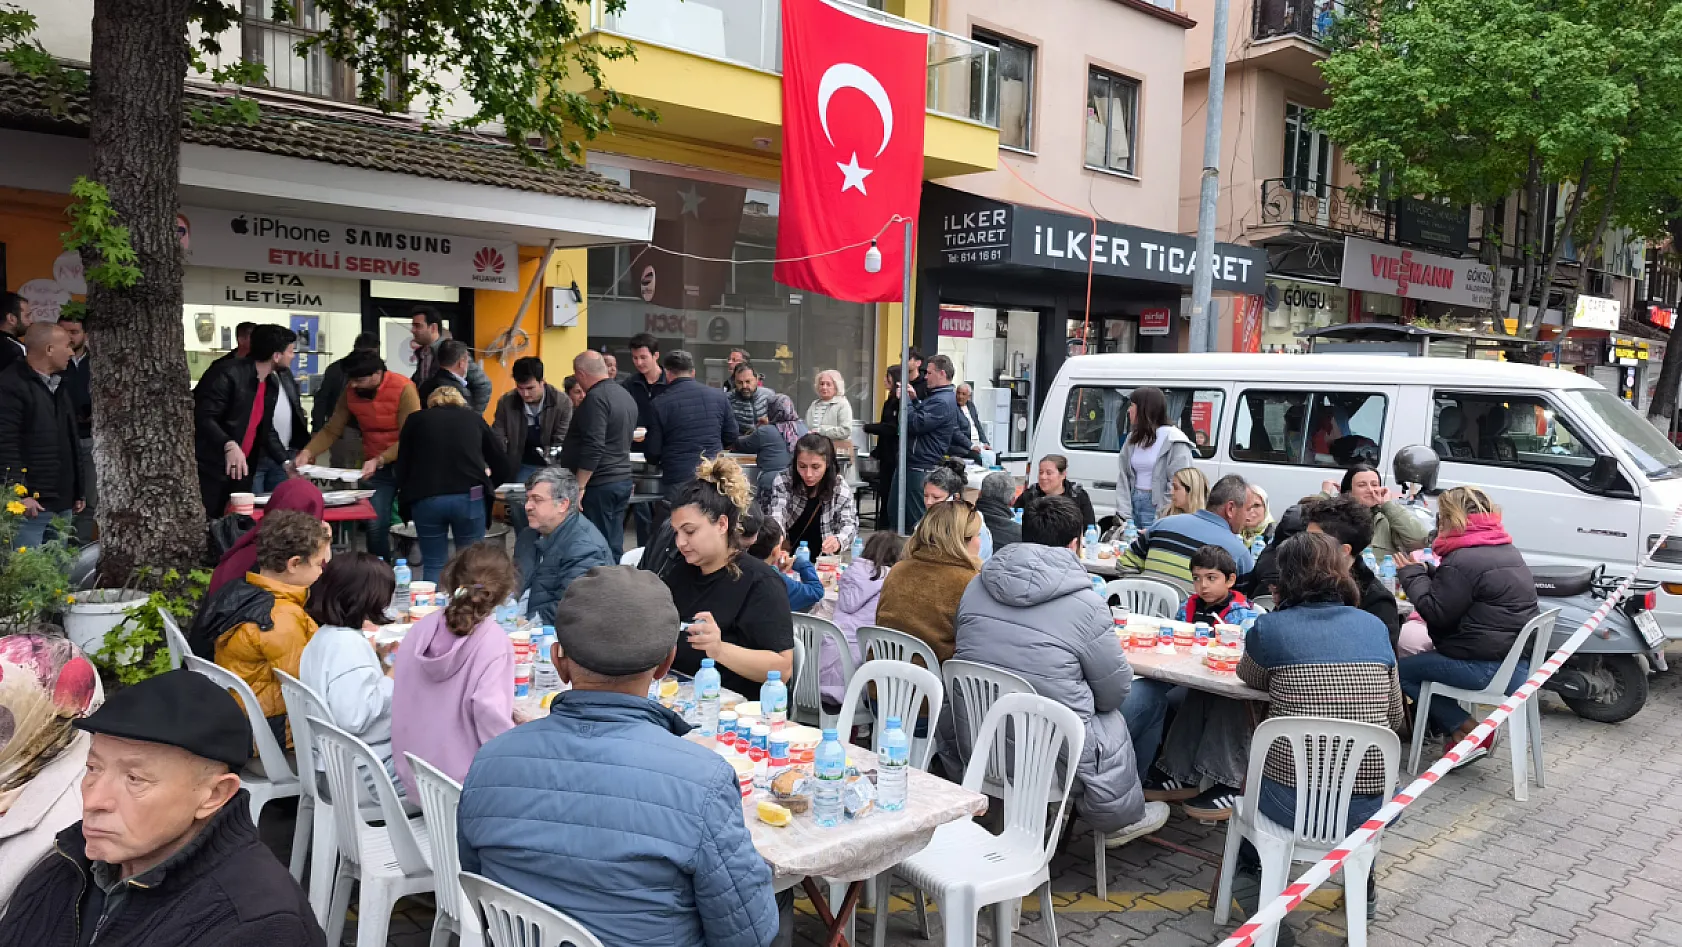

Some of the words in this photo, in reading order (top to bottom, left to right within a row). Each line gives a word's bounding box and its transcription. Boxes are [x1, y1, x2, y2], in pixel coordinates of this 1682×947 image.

[253, 217, 330, 243] iPhone
[345, 228, 451, 254] SAMSUNG
[268, 248, 340, 270] ETKİLİ
[960, 252, 976, 262] 614
[991, 249, 1001, 260] 61
[244, 271, 304, 287] BETA
[472, 274, 506, 284] HUAWEI
[1371, 250, 1454, 296] VIESSMANN
[1467, 267, 1492, 284] GÖKSU
[225, 285, 322, 308] İLETİŞİM
[1284, 284, 1325, 310] GÖKSU
[942, 318, 971, 332] ALTUS
